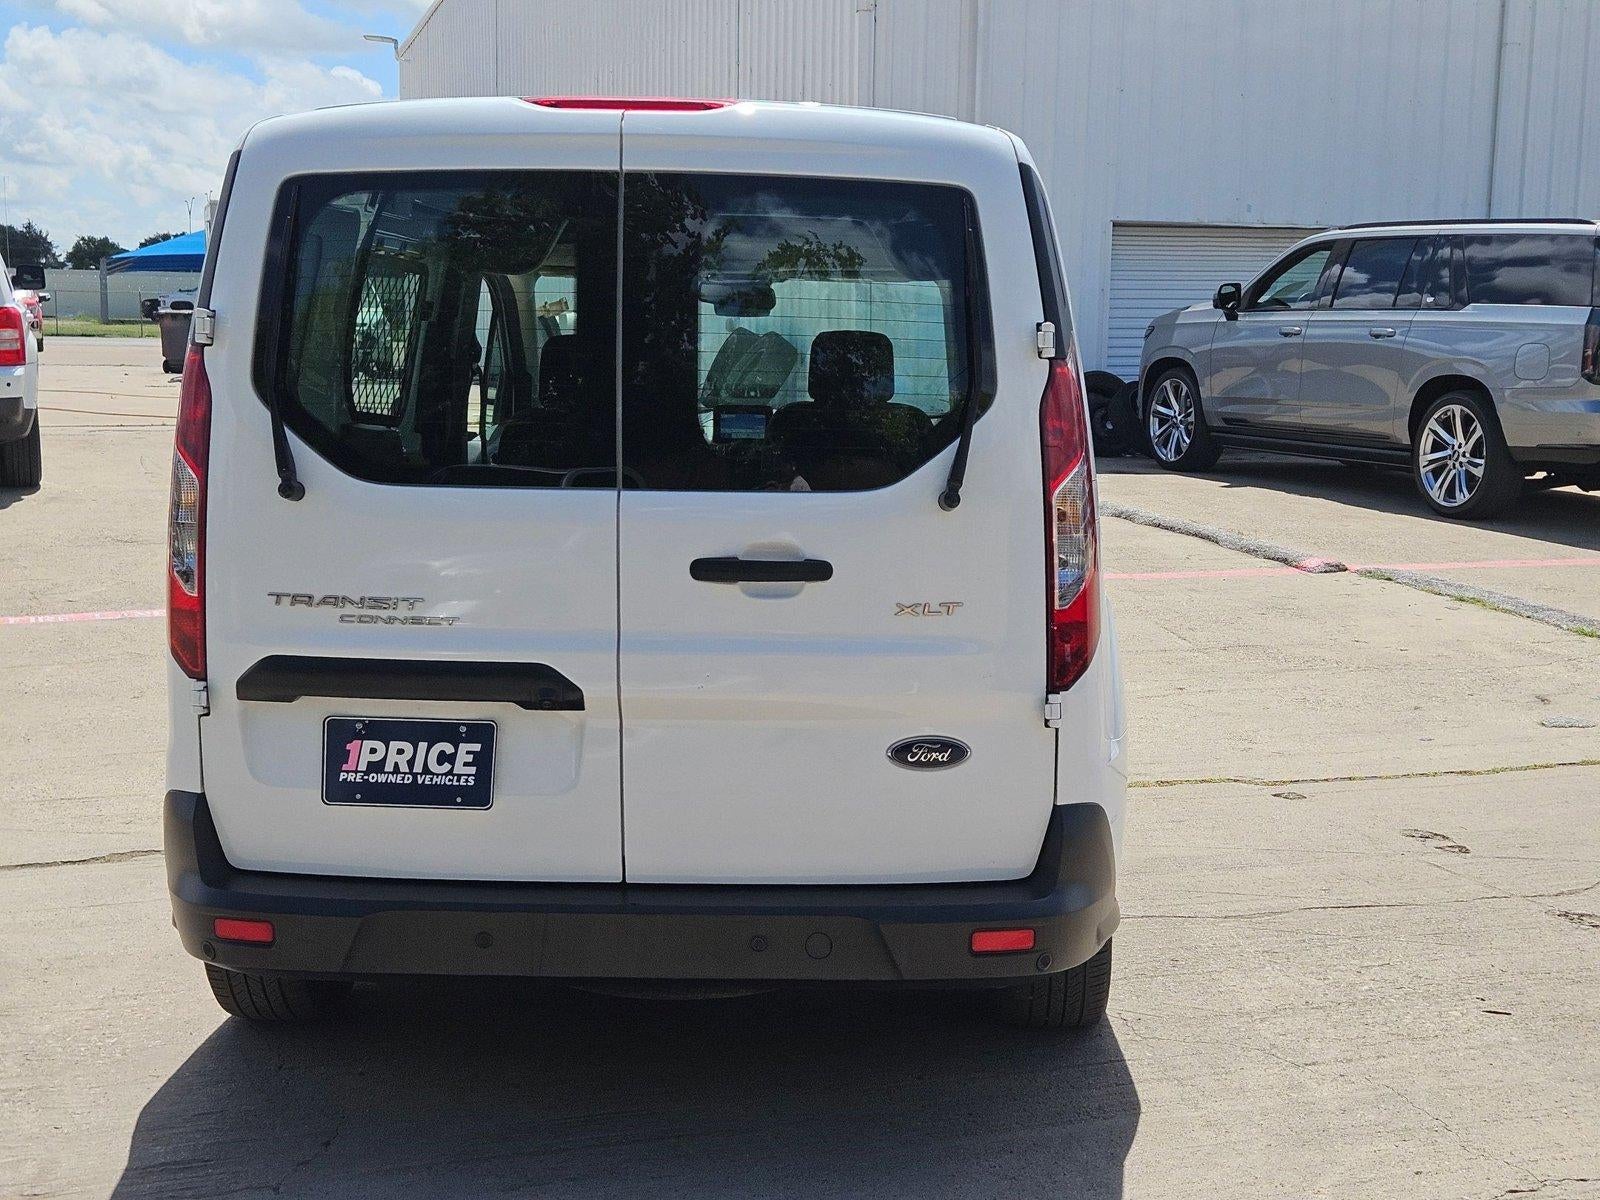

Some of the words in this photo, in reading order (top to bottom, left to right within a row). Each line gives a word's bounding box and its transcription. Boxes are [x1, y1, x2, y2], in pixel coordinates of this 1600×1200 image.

[267, 592, 425, 611] TRANSIT
[894, 602, 964, 617] XLT
[338, 613, 460, 626] CONNECT
[907, 743, 951, 762] Ford
[339, 772, 413, 784] PRE-OWNED
[417, 774, 476, 786] VEHICLES
